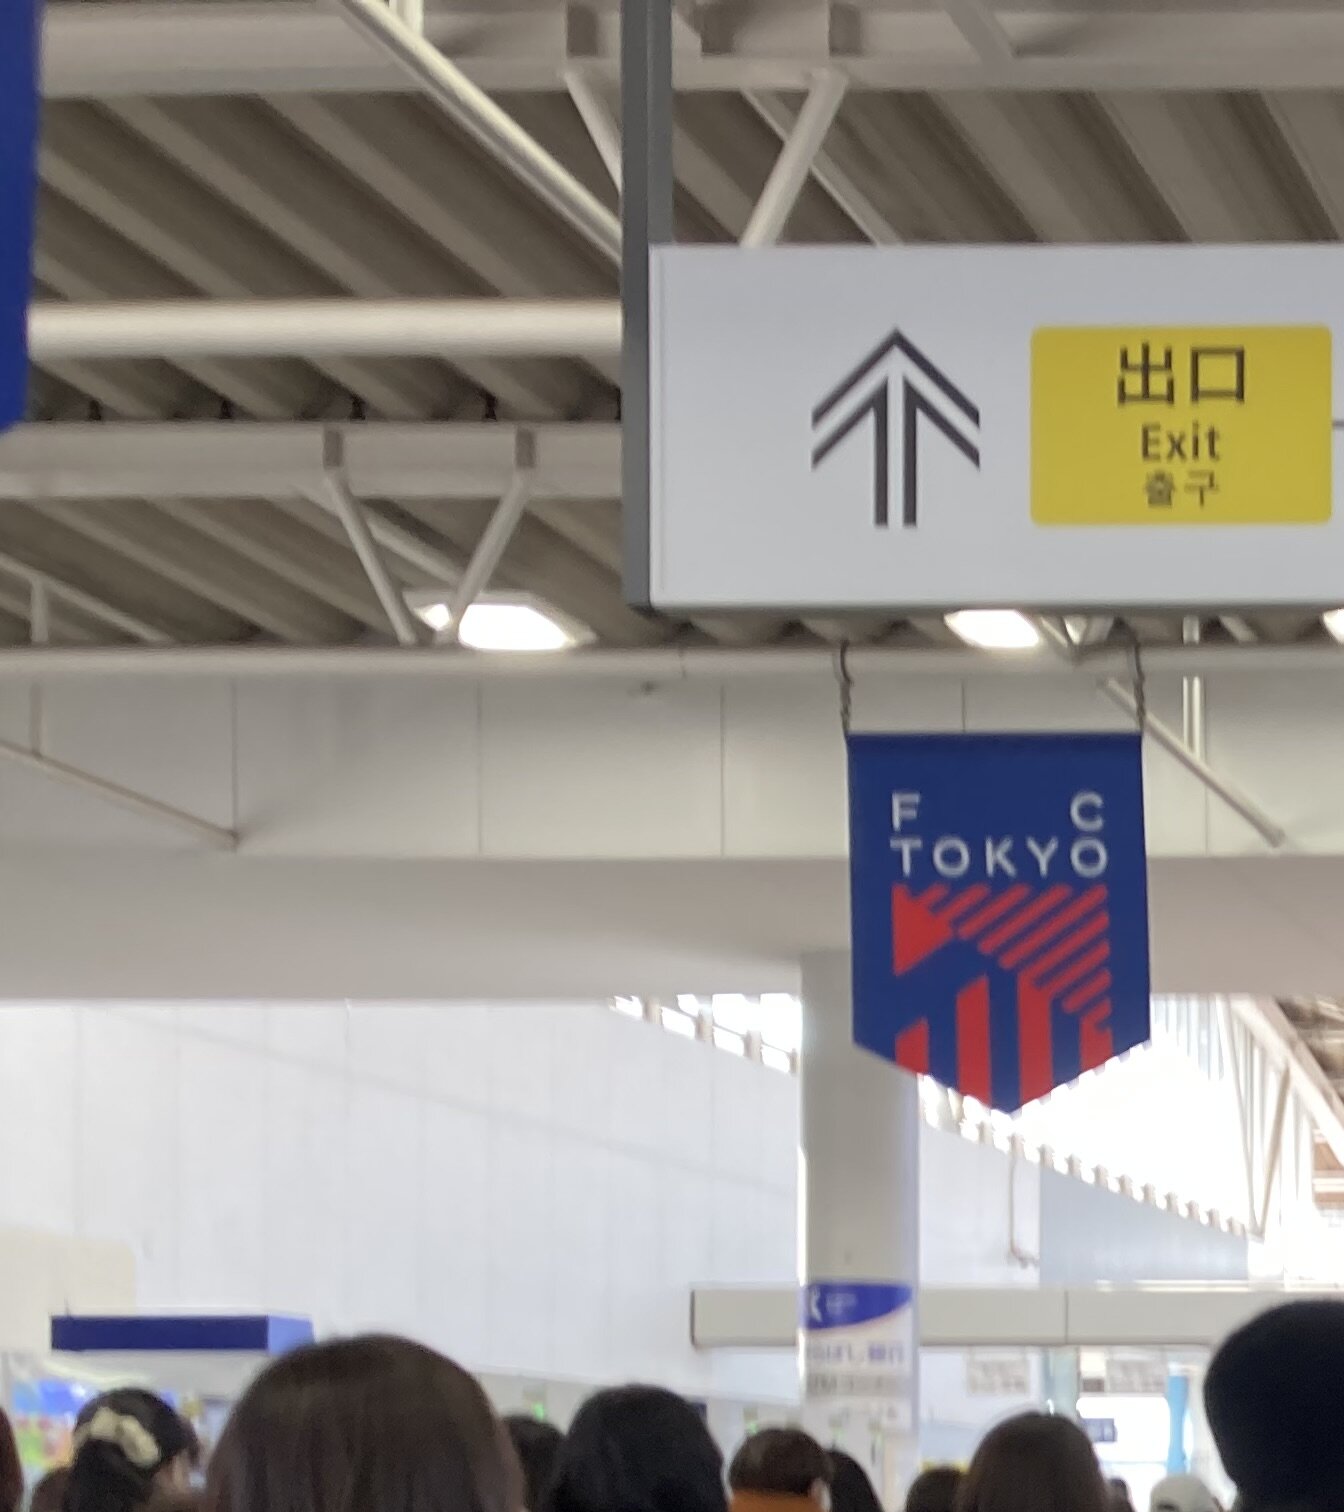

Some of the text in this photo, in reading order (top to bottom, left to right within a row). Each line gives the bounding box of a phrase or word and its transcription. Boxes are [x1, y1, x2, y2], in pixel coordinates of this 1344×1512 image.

[1118, 341, 1246, 405] 出口
[1142, 421, 1220, 461] Exit
[890, 836, 1108, 879] TOKYO
